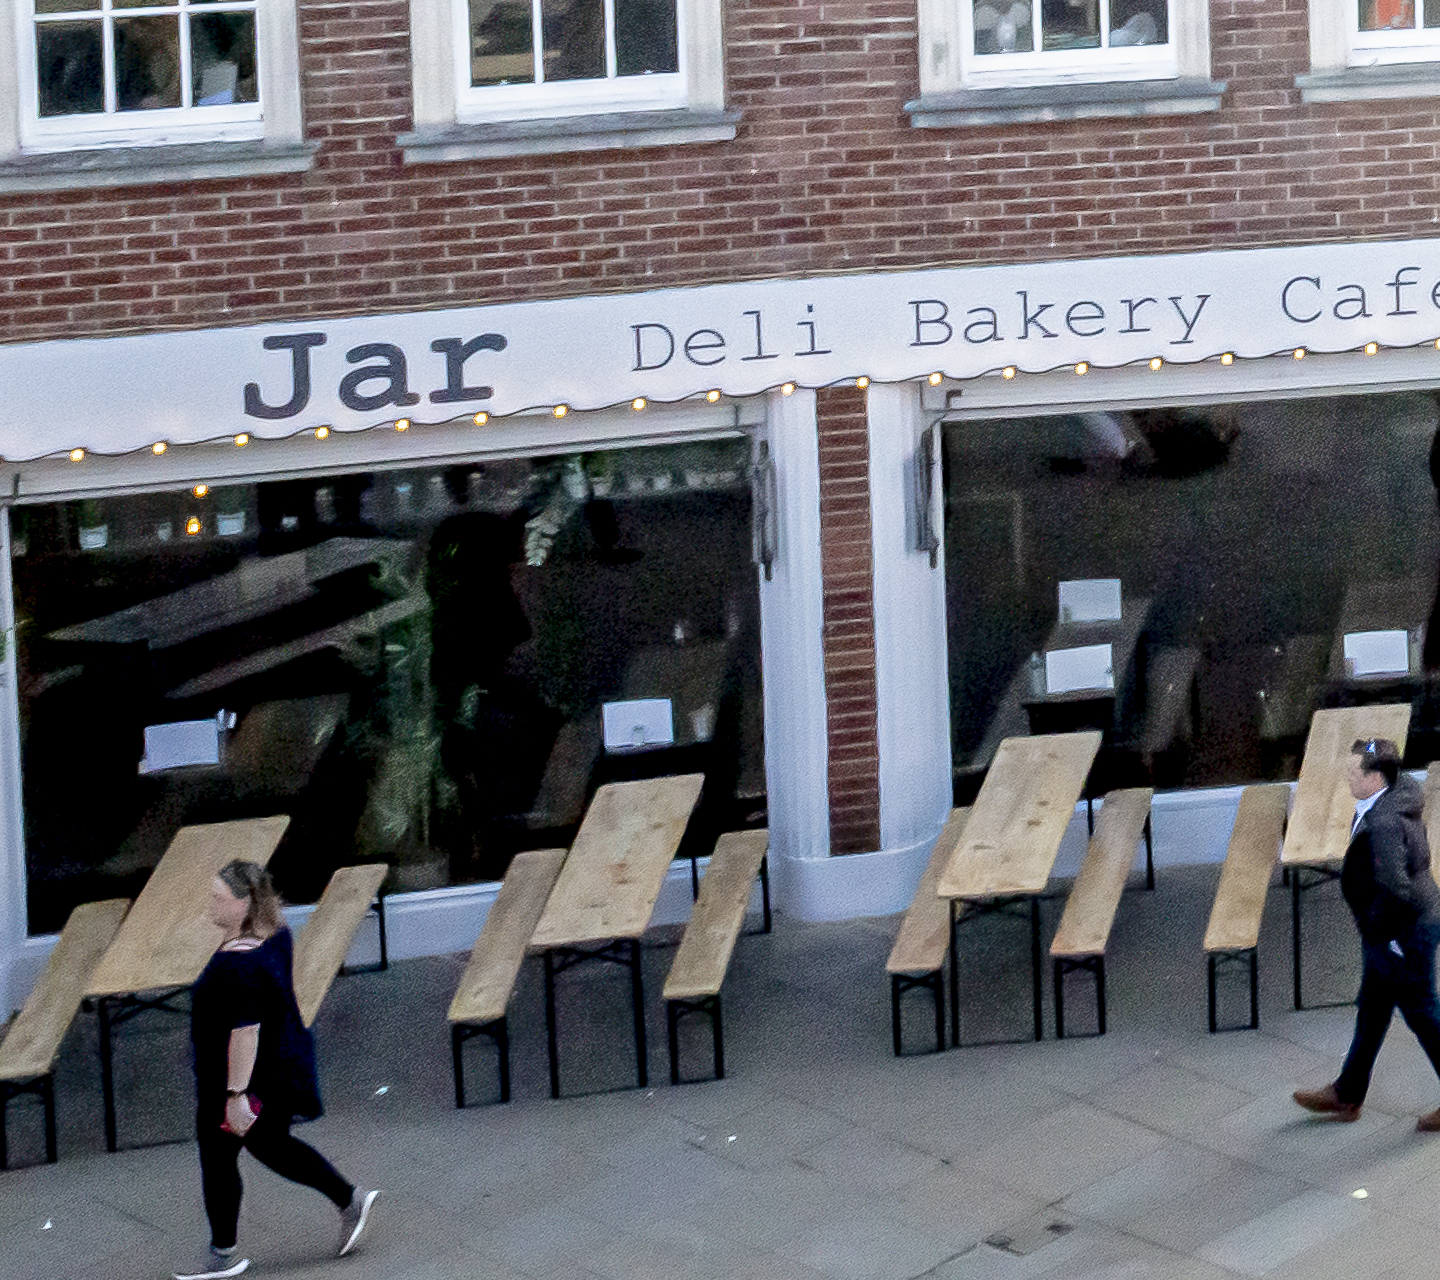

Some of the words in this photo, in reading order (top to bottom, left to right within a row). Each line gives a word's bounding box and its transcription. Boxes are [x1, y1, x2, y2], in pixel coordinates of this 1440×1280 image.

[243, 332, 508, 420] Jar
[631, 303, 833, 372] Deli
[909, 290, 1212, 345] Bakery
